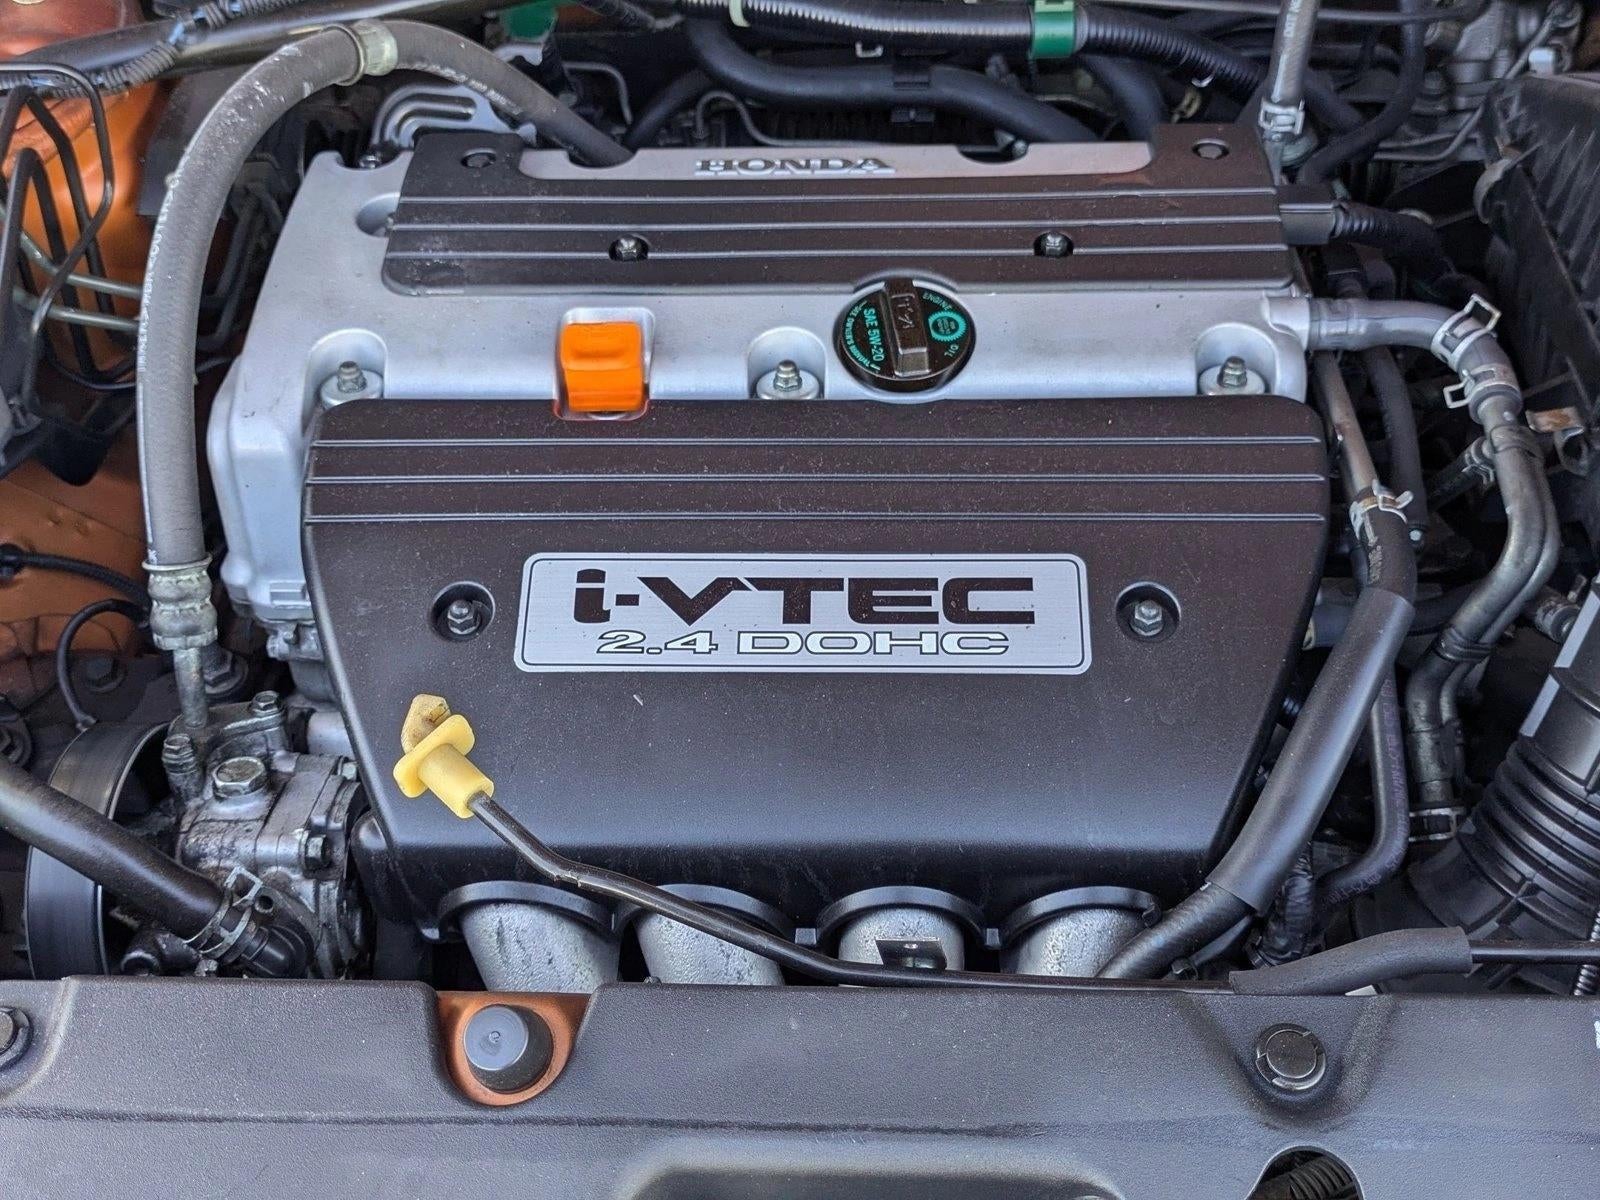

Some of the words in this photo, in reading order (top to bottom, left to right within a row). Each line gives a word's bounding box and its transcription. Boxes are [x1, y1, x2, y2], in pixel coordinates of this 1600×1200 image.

[694, 158, 896, 176] HONDA
[922, 291, 953, 311] ENGINE
[863, 307, 879, 327] SAE
[868, 328, 885, 361] 5W-20
[943, 344, 959, 358] OIL
[849, 345, 871, 368] MANUAL
[574, 568, 1035, 627] i-VTEC
[597, 630, 718, 656] 2.4
[737, 631, 1010, 656] DOHC
